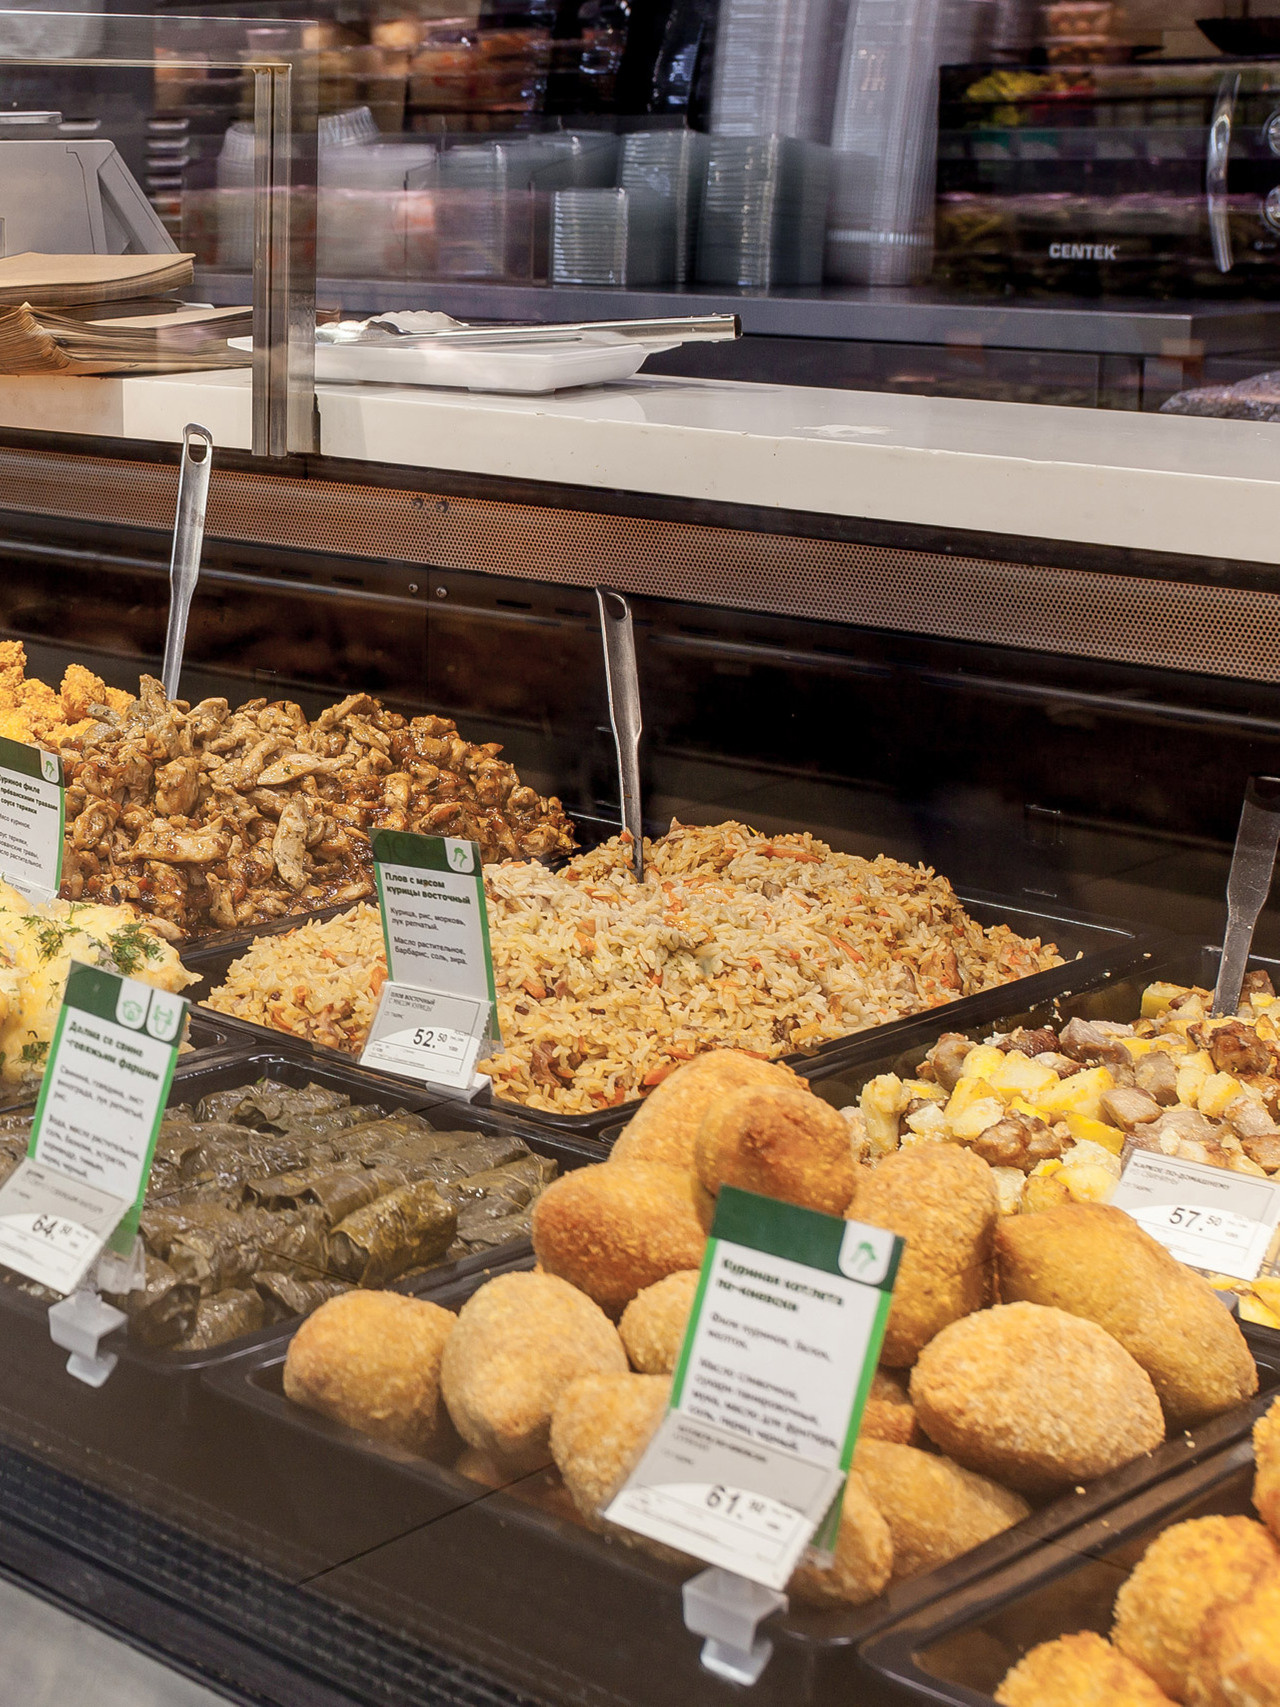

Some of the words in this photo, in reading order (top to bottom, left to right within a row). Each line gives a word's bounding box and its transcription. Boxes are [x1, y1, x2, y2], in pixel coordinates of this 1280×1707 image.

[1049, 242, 1117, 260] CENTEK
[23, 783, 40, 794] филе
[385, 872, 408, 883] Плов
[416, 878, 445, 888] мясом
[387, 886, 421, 897] курицы
[422, 891, 471, 904] восточный
[394, 936, 416, 946] Масло
